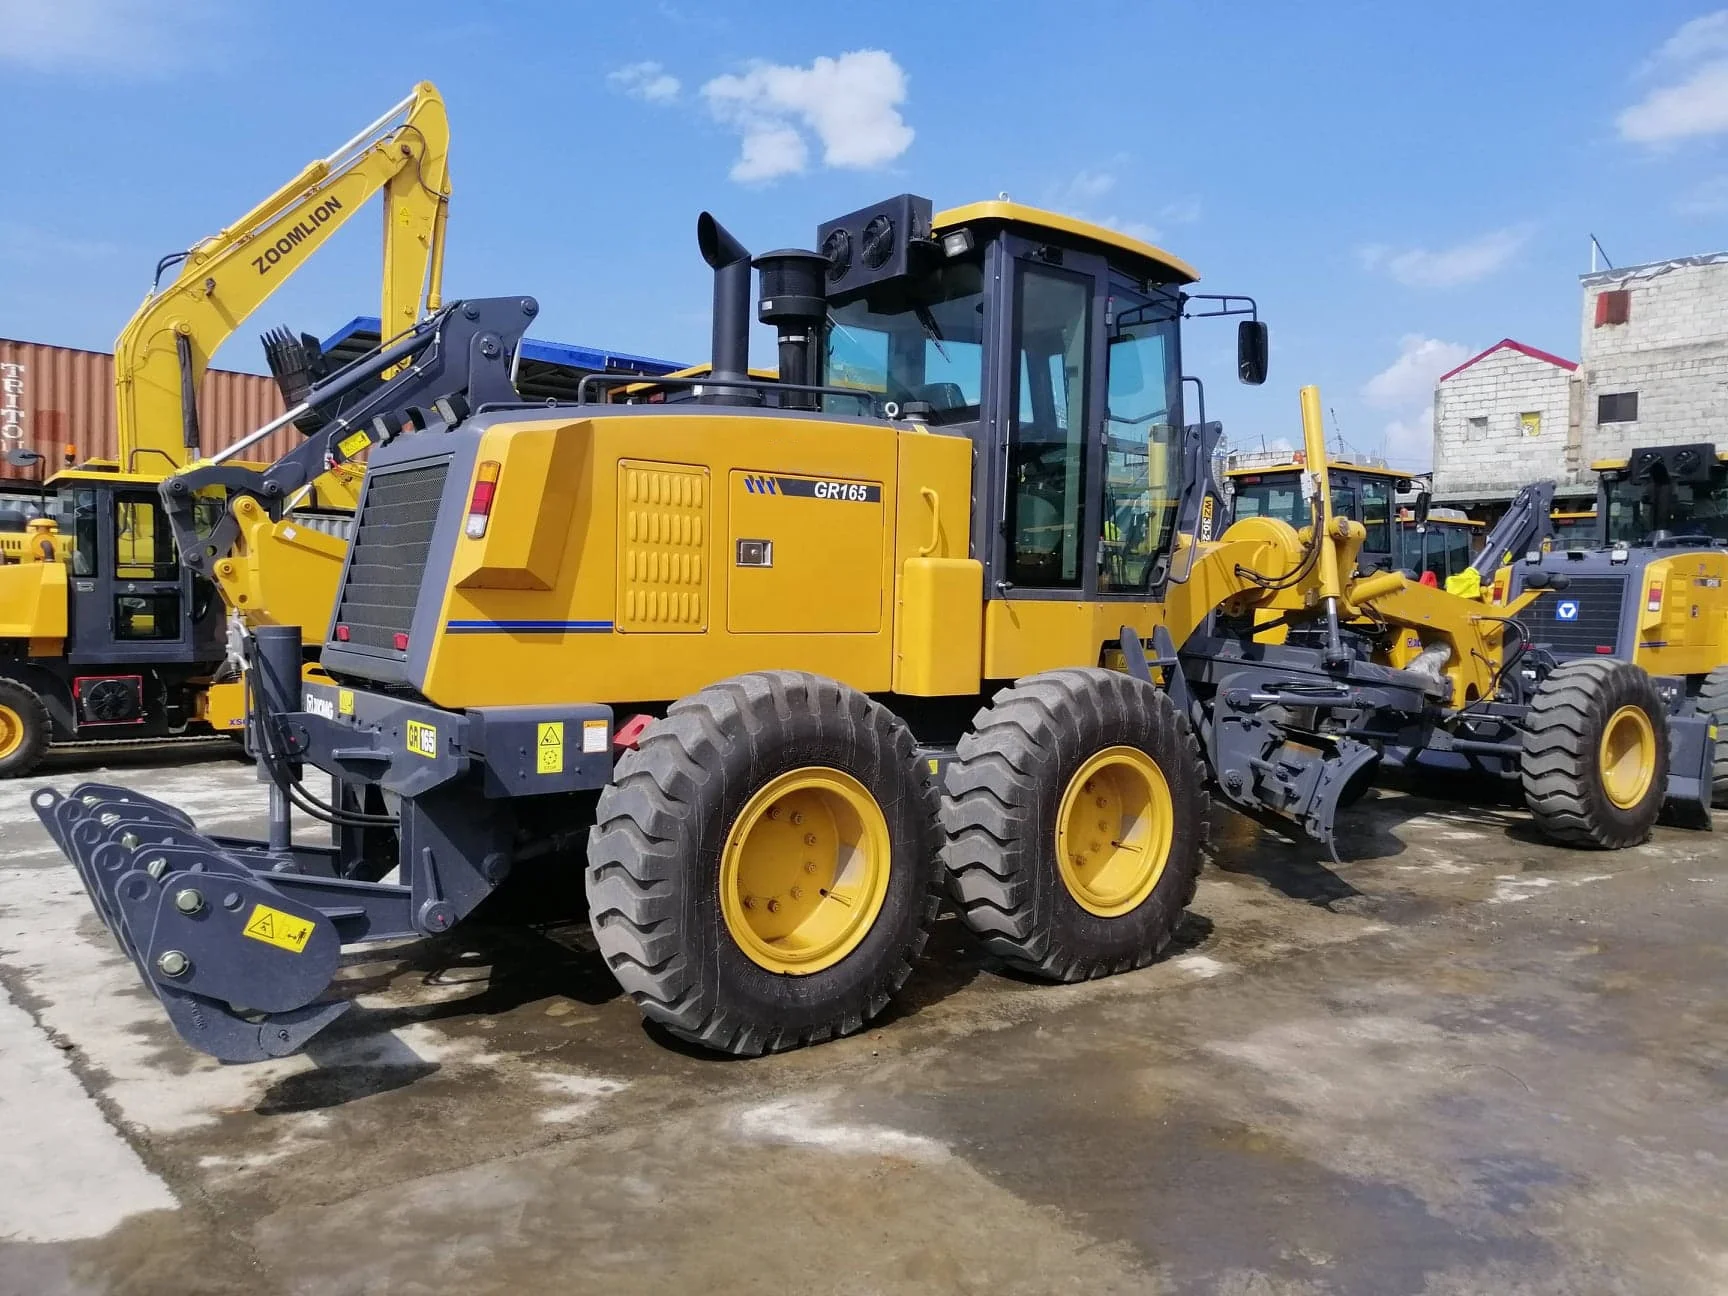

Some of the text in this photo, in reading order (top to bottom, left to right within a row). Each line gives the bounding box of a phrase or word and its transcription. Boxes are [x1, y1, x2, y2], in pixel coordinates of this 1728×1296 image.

[251, 195, 343, 275] ZOOMLION
[814, 482, 867, 501] GR165
[408, 724, 434, 753] GR 165
